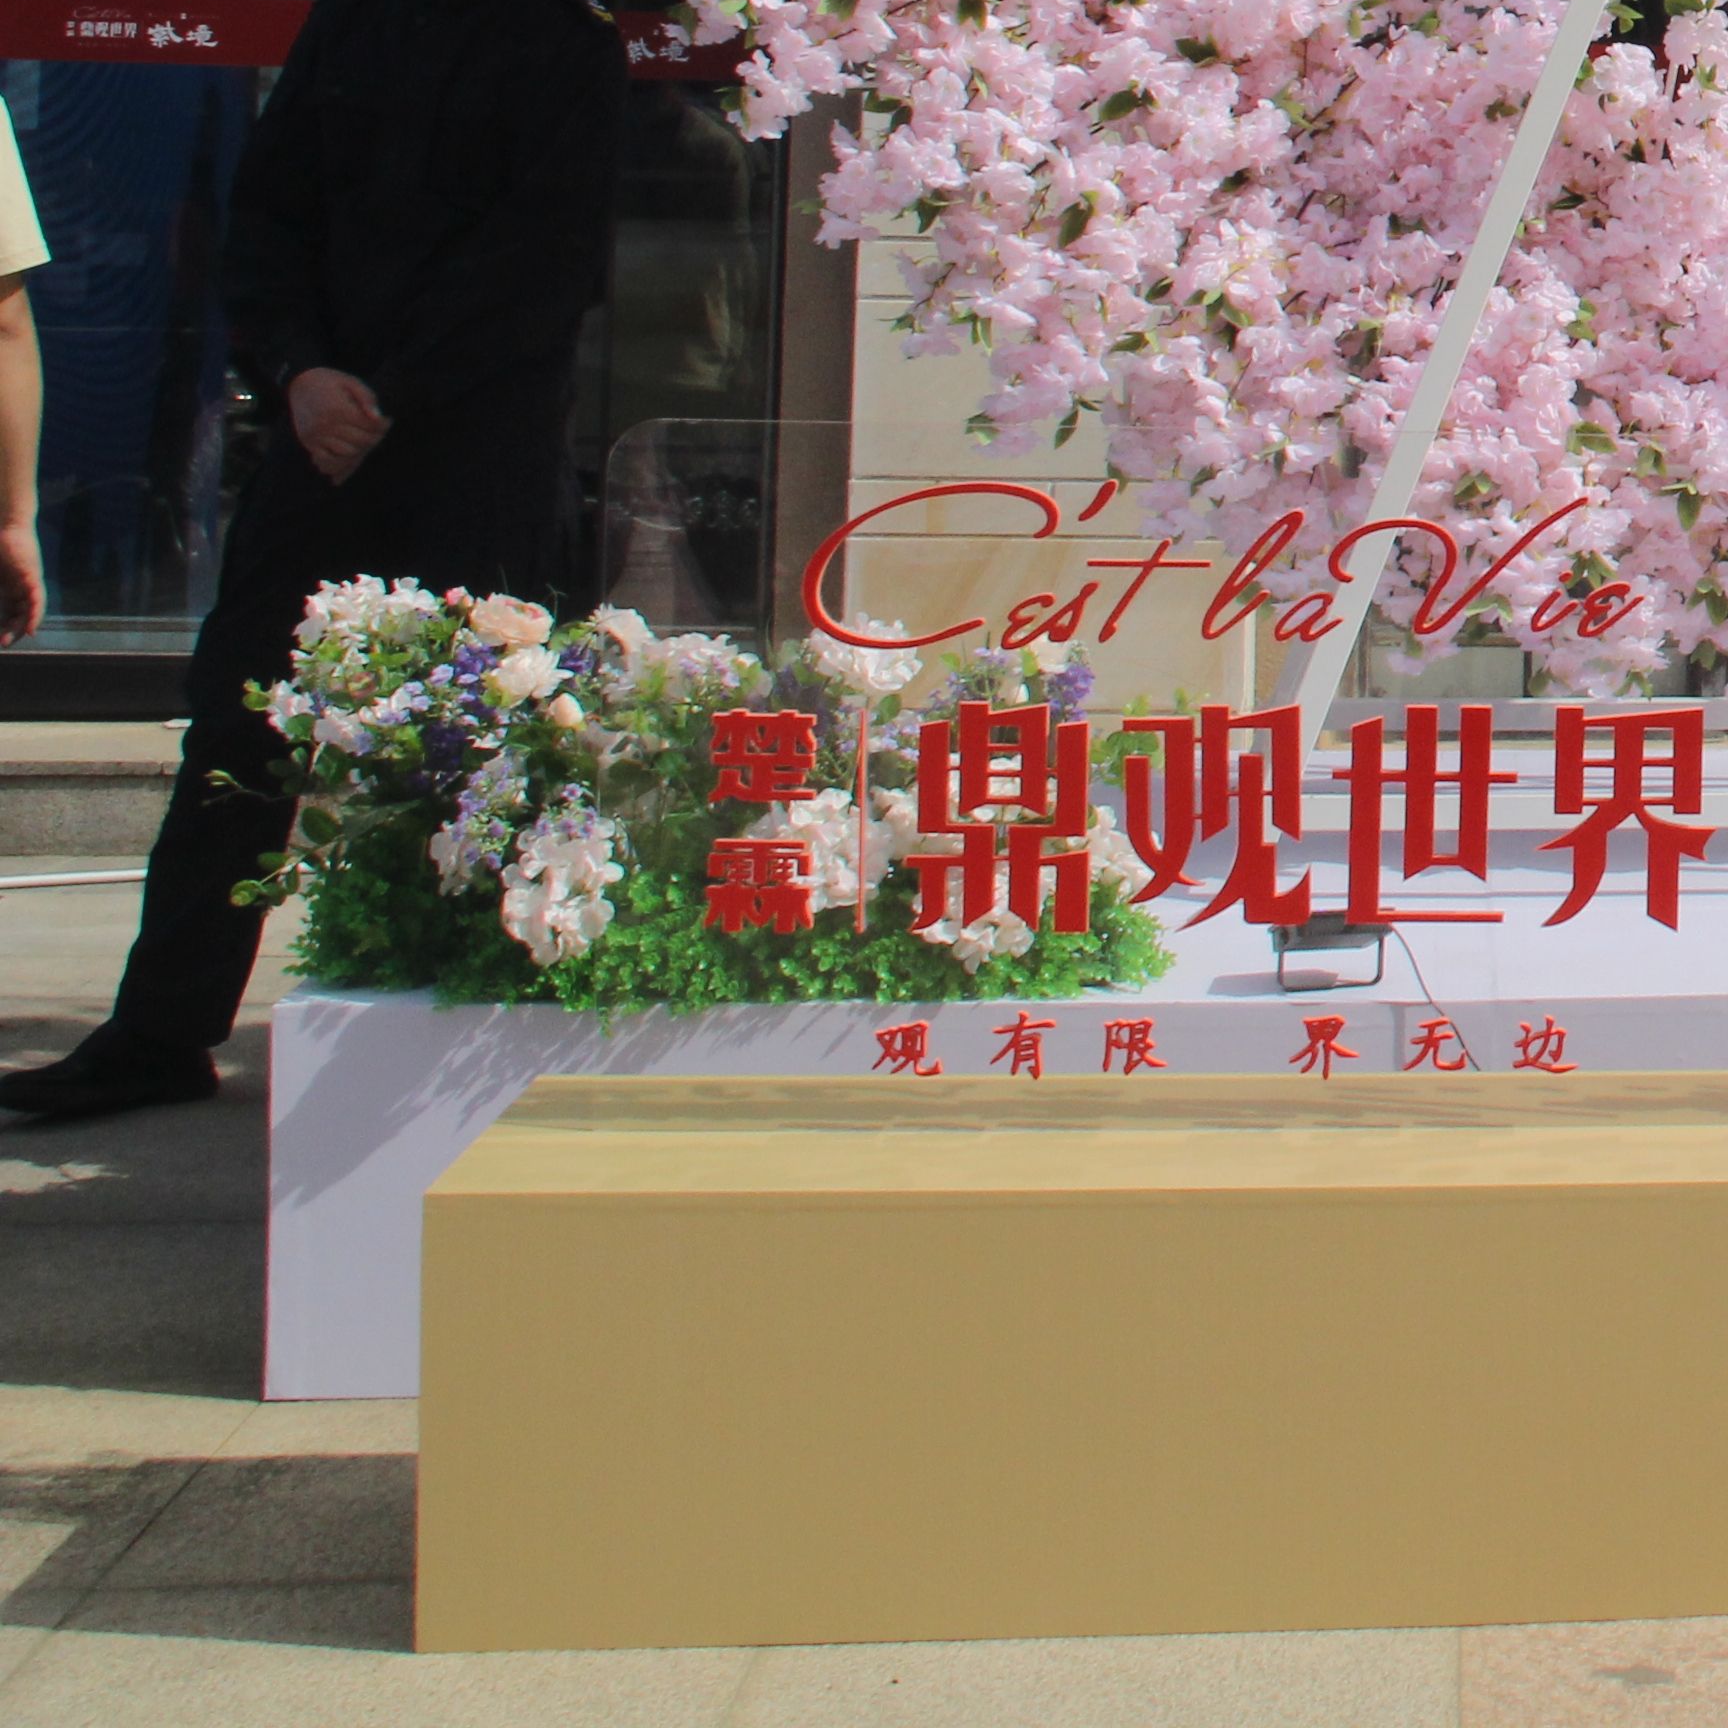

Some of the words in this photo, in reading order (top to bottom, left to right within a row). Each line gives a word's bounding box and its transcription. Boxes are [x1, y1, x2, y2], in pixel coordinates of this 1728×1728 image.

[147, 21, 220, 50] 紫境
[802, 480, 1212, 650] C'est
[1328, 496, 1645, 638] Vie
[704, 708, 817, 933] 楚霖
[905, 703, 1717, 933] 鼎观世界
[874, 1010, 1168, 1079] 观有限
[1289, 1015, 1578, 1080] 界无边
